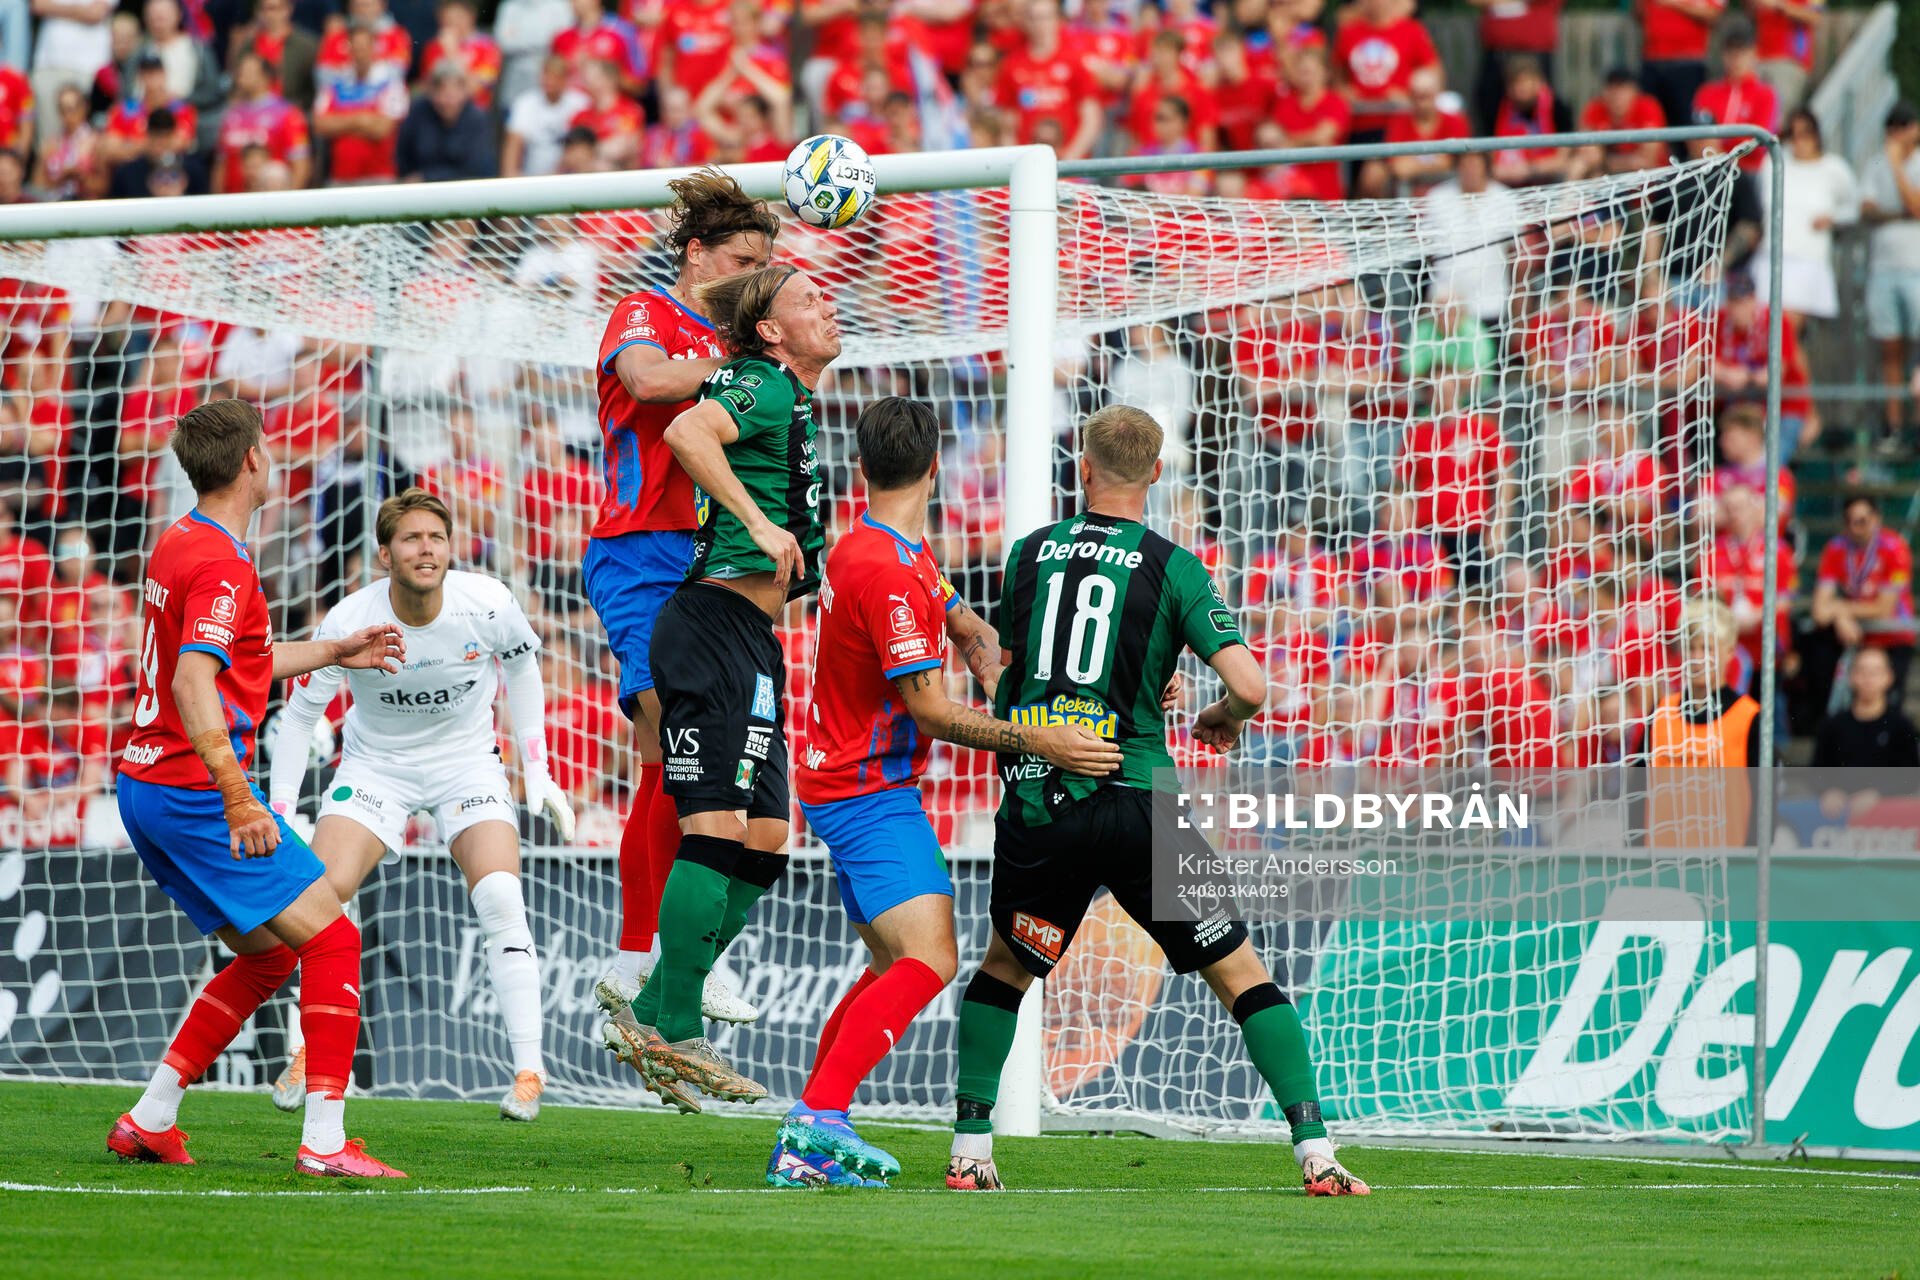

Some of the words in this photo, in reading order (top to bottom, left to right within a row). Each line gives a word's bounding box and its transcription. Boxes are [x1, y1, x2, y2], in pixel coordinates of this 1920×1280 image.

[836, 165, 875, 186] SELECT
[620, 326, 657, 340] UNIBET
[1035, 540, 1143, 569] Derome
[198, 622, 235, 643] UNIBET
[1034, 572, 1117, 685] 18
[501, 641, 533, 660] XXL
[890, 638, 928, 655] UNIBET
[135, 617, 160, 728] 9
[380, 688, 450, 706] akea
[1052, 695, 1104, 716] Gekås
[666, 727, 700, 755] VS
[745, 740, 769, 755] BYGG
[667, 757, 699, 766] VARBERGS
[686, 774, 699, 782] SPA
[355, 788, 383, 809] Solid
[1015, 912, 1062, 947] FMP
[1208, 930, 1224, 944] ASIA
